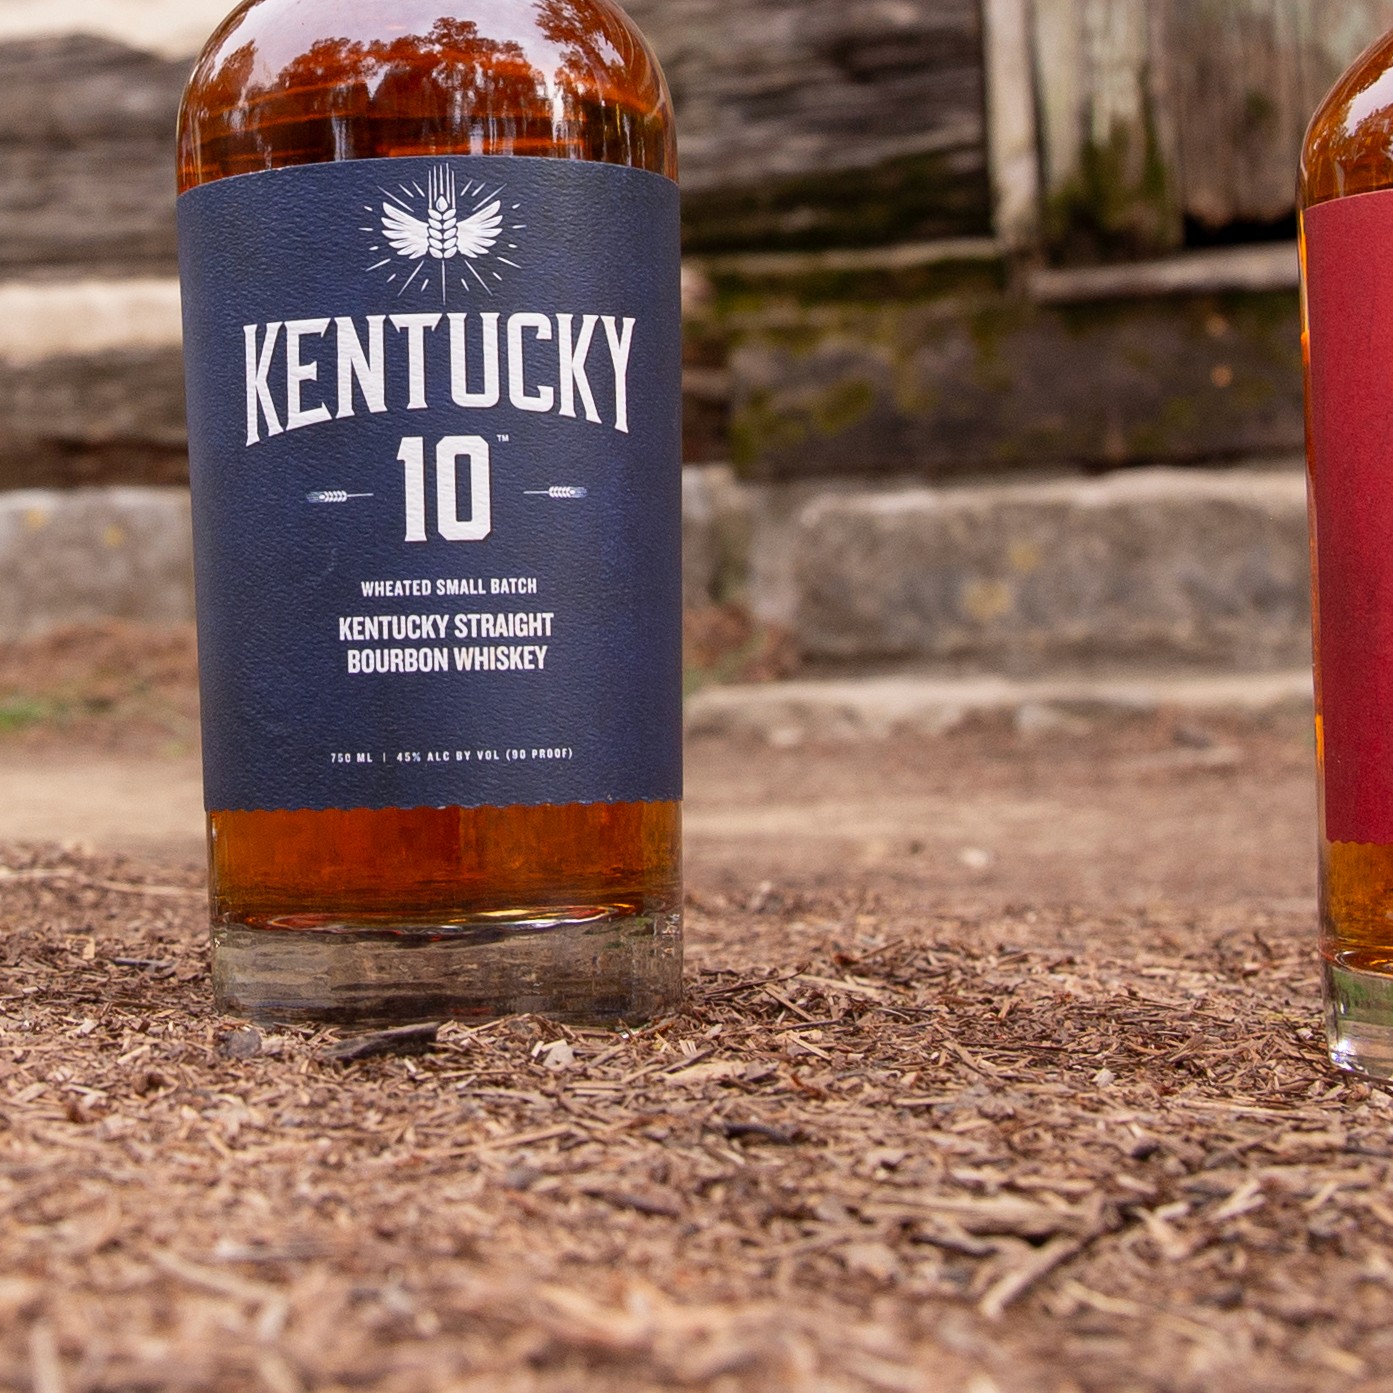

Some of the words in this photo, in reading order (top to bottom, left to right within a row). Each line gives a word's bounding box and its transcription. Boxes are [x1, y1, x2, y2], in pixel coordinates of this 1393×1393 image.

[243, 312, 636, 447] KENTUCKY
[396, 436, 491, 542] 10
[361, 579, 432, 597] WHEATED
[436, 579, 486, 596] SMALL
[490, 577, 538, 594] BATCH
[339, 614, 449, 641] KENTUCKY
[454, 612, 555, 638] STRAIGHT
[347, 648, 449, 674] BOURBON
[453, 645, 548, 671] WHISKEY
[330, 752, 352, 764] 750
[356, 752, 373, 763] ML
[396, 751, 422, 762] 45%
[427, 750, 450, 762] ALC
[456, 750, 471, 761] BY
[476, 750, 500, 760] VOL
[505, 748, 527, 762] (90
[531, 747, 574, 760] PROOF)
